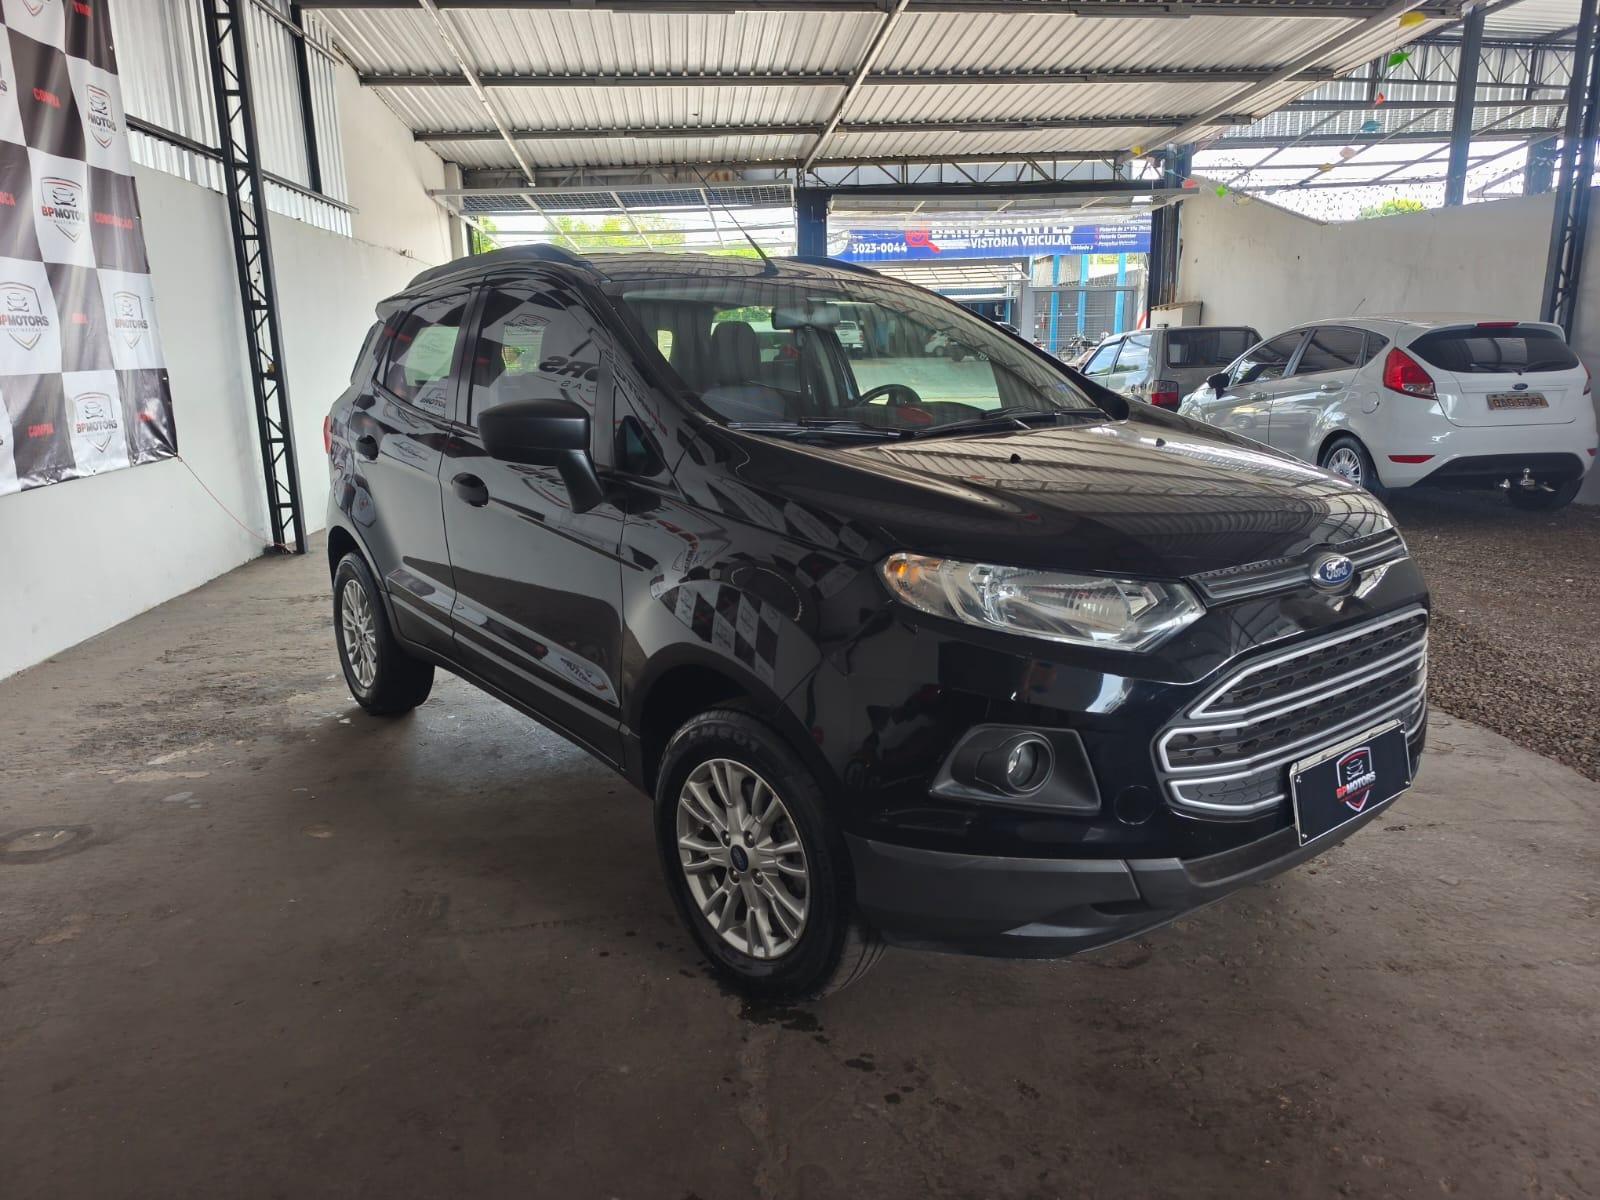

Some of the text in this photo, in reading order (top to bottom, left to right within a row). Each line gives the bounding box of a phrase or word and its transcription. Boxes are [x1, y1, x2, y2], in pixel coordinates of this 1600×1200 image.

[852, 242, 908, 254] 3023-0044
[970, 236, 1019, 249] VISTORIA
[76, 419, 118, 434] BPMOTORS
[1326, 560, 1348, 581] Ford
[1336, 771, 1377, 799] BPMOTORS
